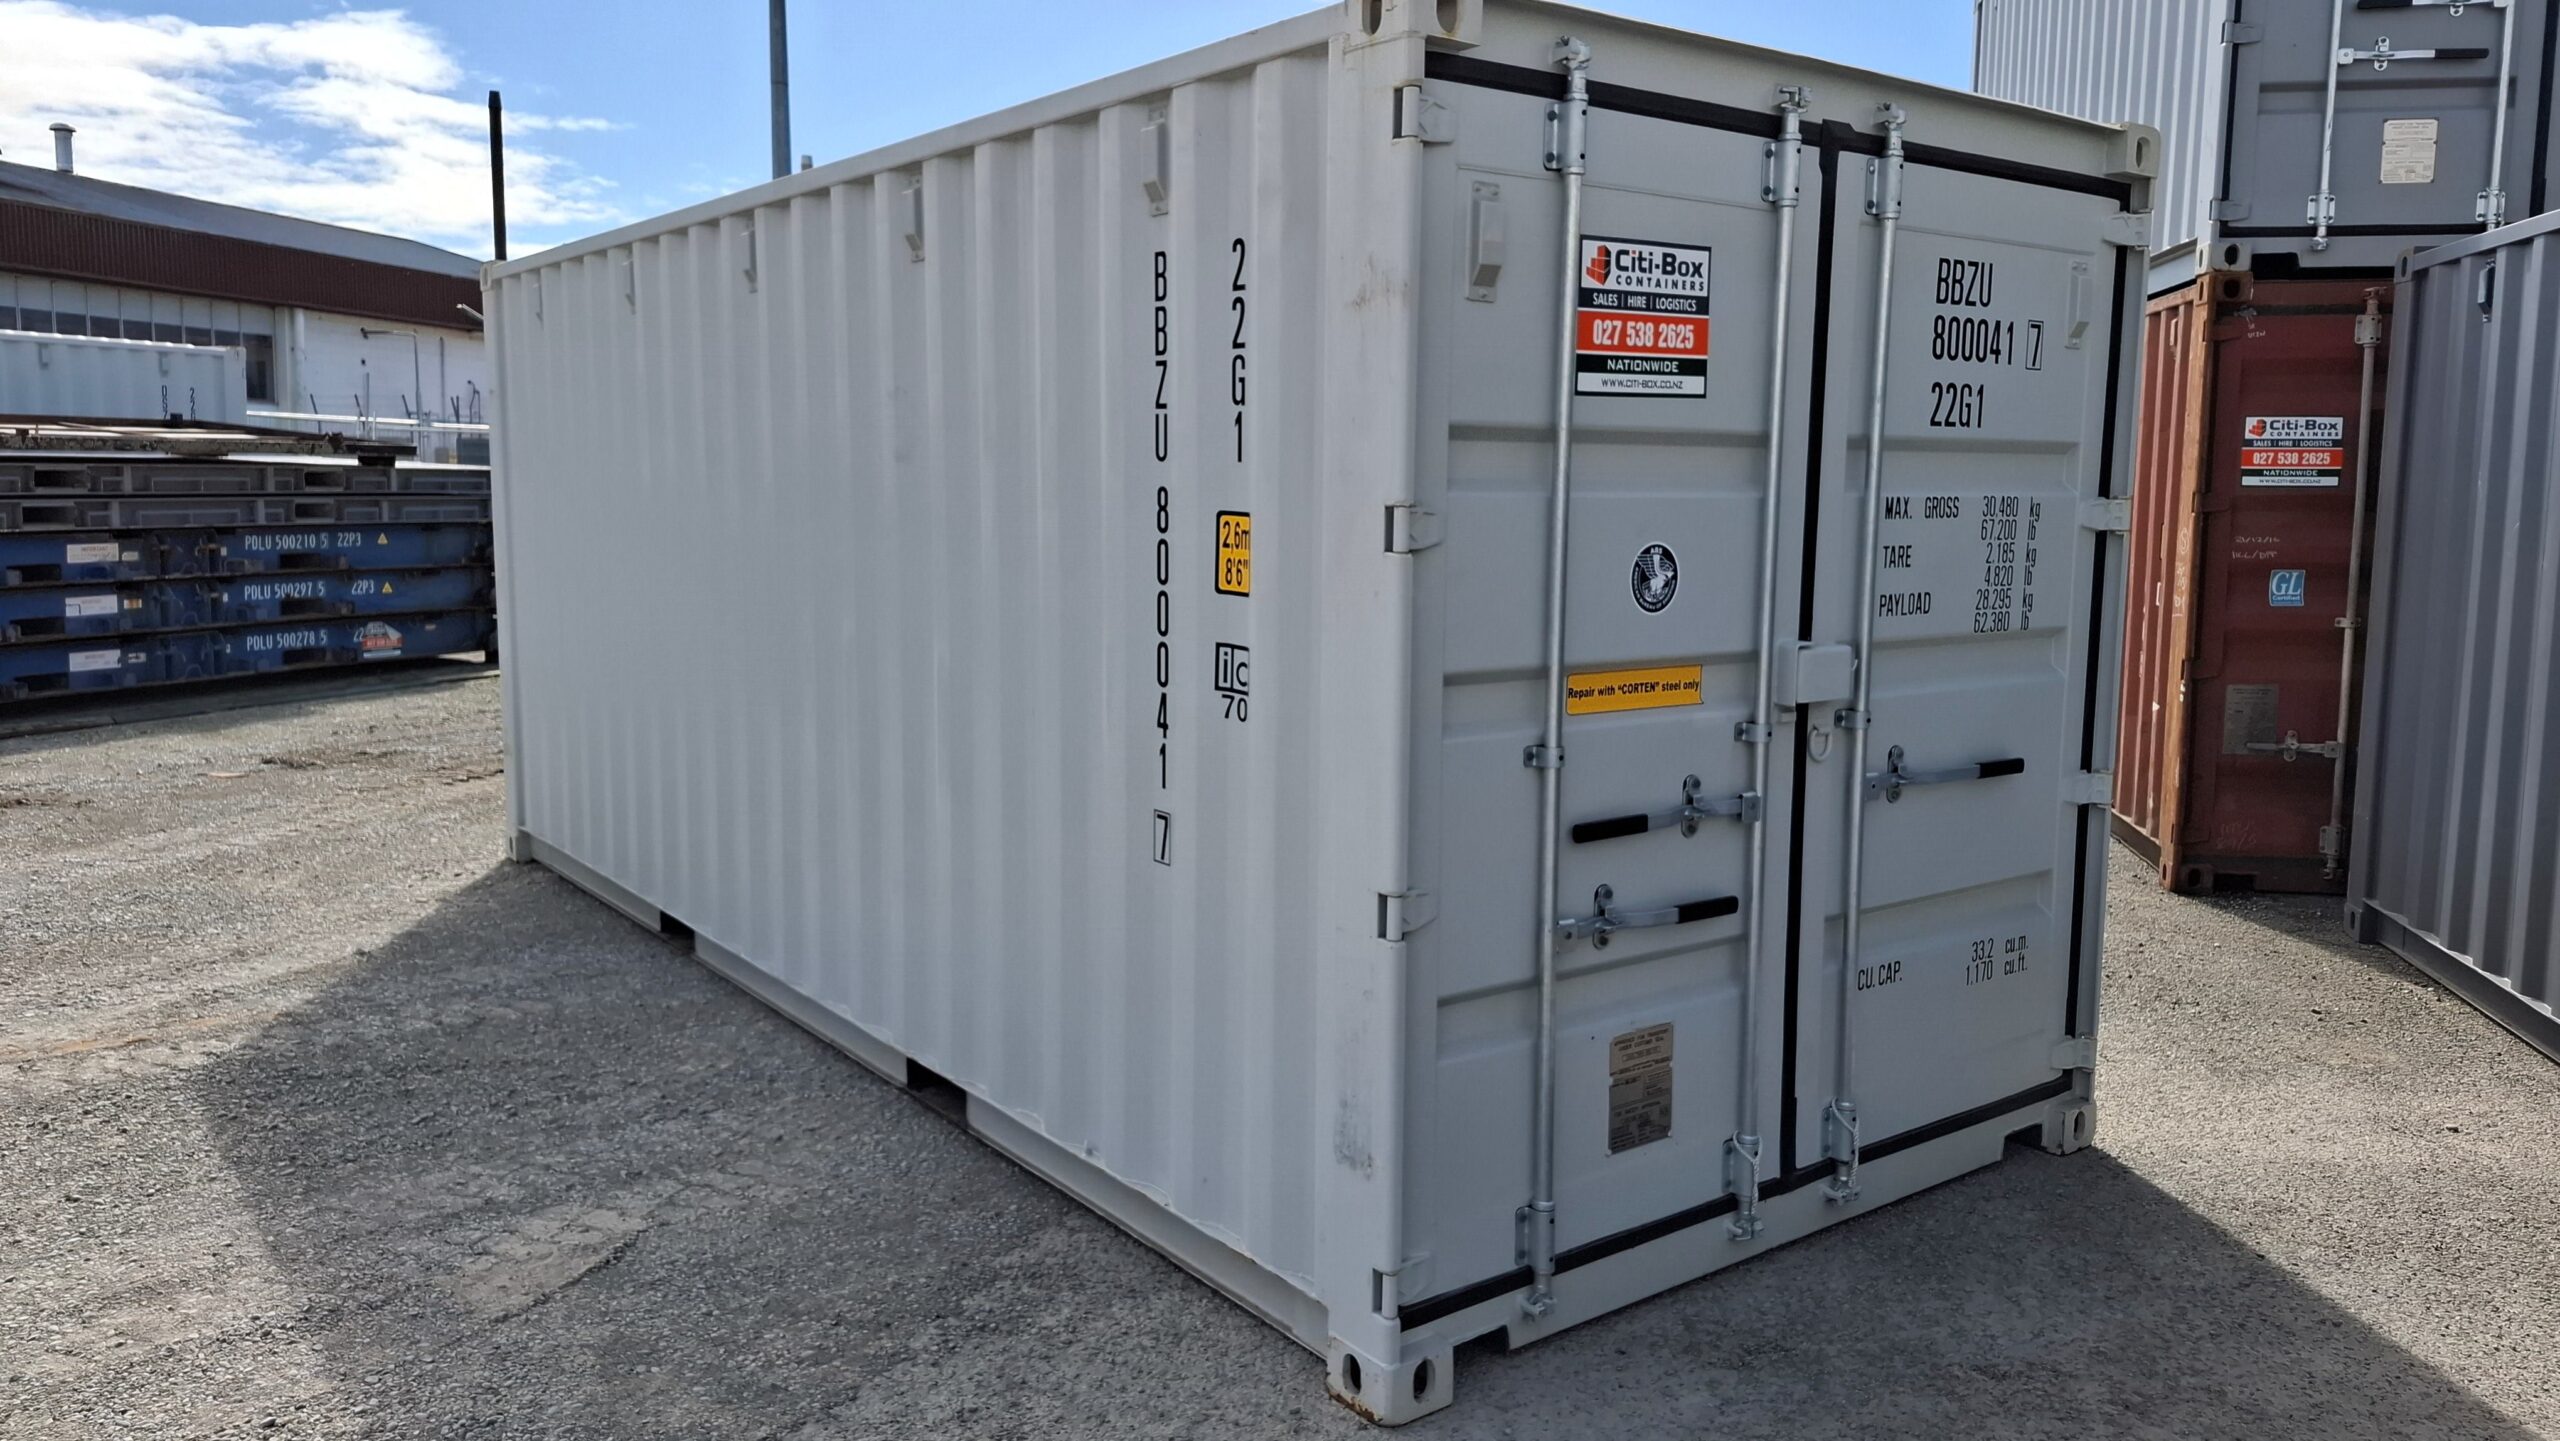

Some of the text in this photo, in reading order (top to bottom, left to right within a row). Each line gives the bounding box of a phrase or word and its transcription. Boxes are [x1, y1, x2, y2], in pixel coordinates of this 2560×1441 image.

[1615, 249, 1704, 279] Citi-Box
[1616, 275, 1704, 292] CONTAINERS
[1936, 257, 1994, 307] BBZU
[1593, 292, 1697, 311] SALES HIRE LOGISTICS
[1593, 319, 1695, 349] 027 538 2625
[1932, 315, 2043, 368] 800041 7
[1232, 238, 1246, 462] 22G1
[1607, 359, 1679, 373] NATIONWIDE
[1601, 377, 1684, 390] WWW.CITI-BOX.CO.NZ
[1930, 382, 1984, 428] 22G1
[2269, 419, 2339, 431] Citi-Box
[2253, 452, 2274, 465] 027
[2302, 452, 2331, 465] 2625
[1885, 495, 2041, 522] MAX. GROSS 30.480 kg
[275, 533, 316, 550] 500210
[320, 533, 328, 549] 5
[337, 532, 361, 548] 22P3
[1981, 519, 2037, 541] 67.200 lb
[1154, 250, 1170, 863] BBZU 800041 7
[1883, 542, 2037, 569] TARE 2.185 kg
[1984, 565, 2033, 587] 4.820 lb
[2271, 571, 2301, 595] GL
[274, 582, 312, 599] 500297
[318, 581, 326, 596] 5
[1879, 588, 2033, 617] PAYLOAD 28.295 kg
[1973, 610, 2030, 633] 62.380 lb
[276, 631, 315, 648] 500278
[320, 629, 327, 644] 5
[1568, 686, 1595, 700] Repair
[1598, 685, 1616, 696] with
[1661, 680, 1681, 692] steel
[1683, 679, 1700, 692] only
[1222, 693, 1248, 722] 70
[1971, 938, 1994, 962] 33.2
[2005, 935, 2029, 954] cu.m.
[1966, 952, 2027, 986] 1.170 cu.ft.
